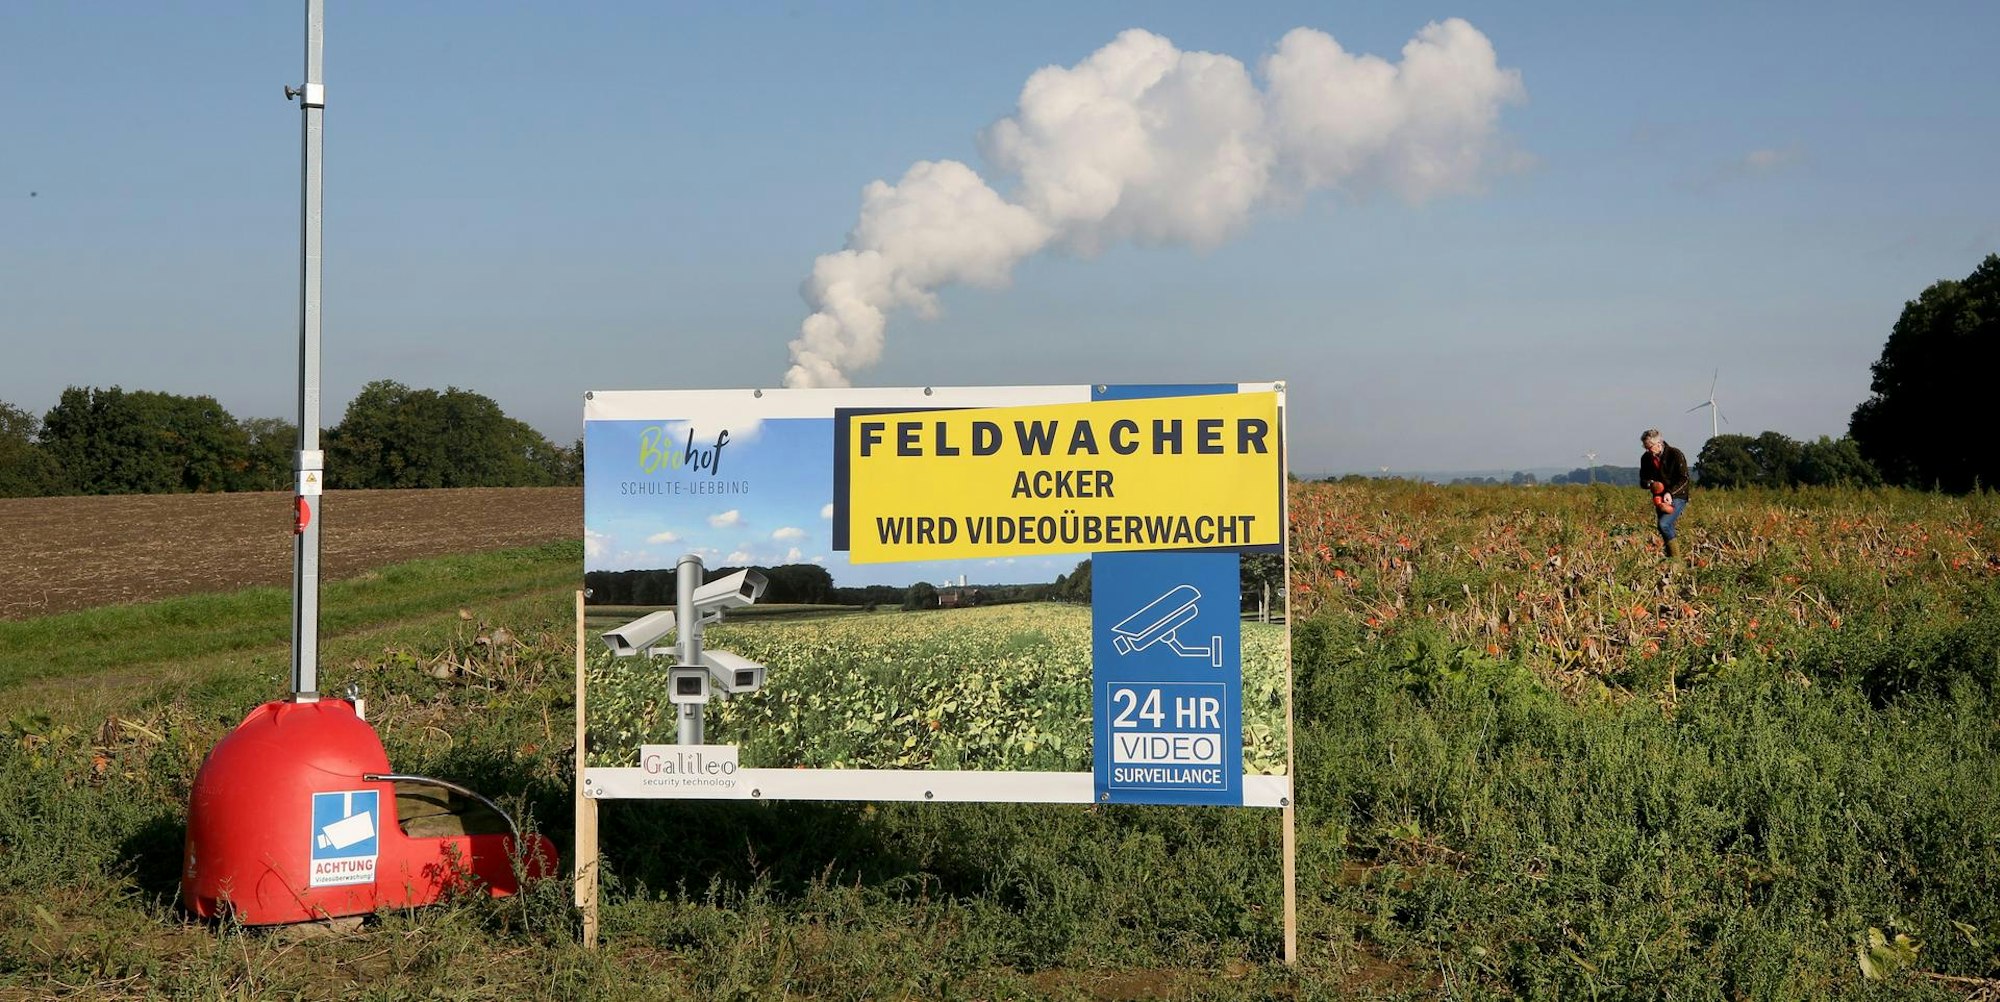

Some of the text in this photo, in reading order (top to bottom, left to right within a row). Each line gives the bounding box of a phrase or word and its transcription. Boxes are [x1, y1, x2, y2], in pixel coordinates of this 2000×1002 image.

[860, 418, 1269, 457] FELDWACHER
[639, 426, 730, 476] Biohof
[621, 480, 749, 495] SCHULTE-UEBBING
[1011, 470, 1114, 499] ACKER
[876, 508, 1256, 545] WIRD VIDEOÜBERWACHT
[1112, 688, 1221, 729] 24 HR
[1120, 736, 1214, 761] VIDEO
[643, 752, 737, 775] Galileo
[1114, 768, 1221, 784] SURVEILLANCE
[643, 778, 736, 788] security technology
[316, 859, 373, 874] ACHTUNG
